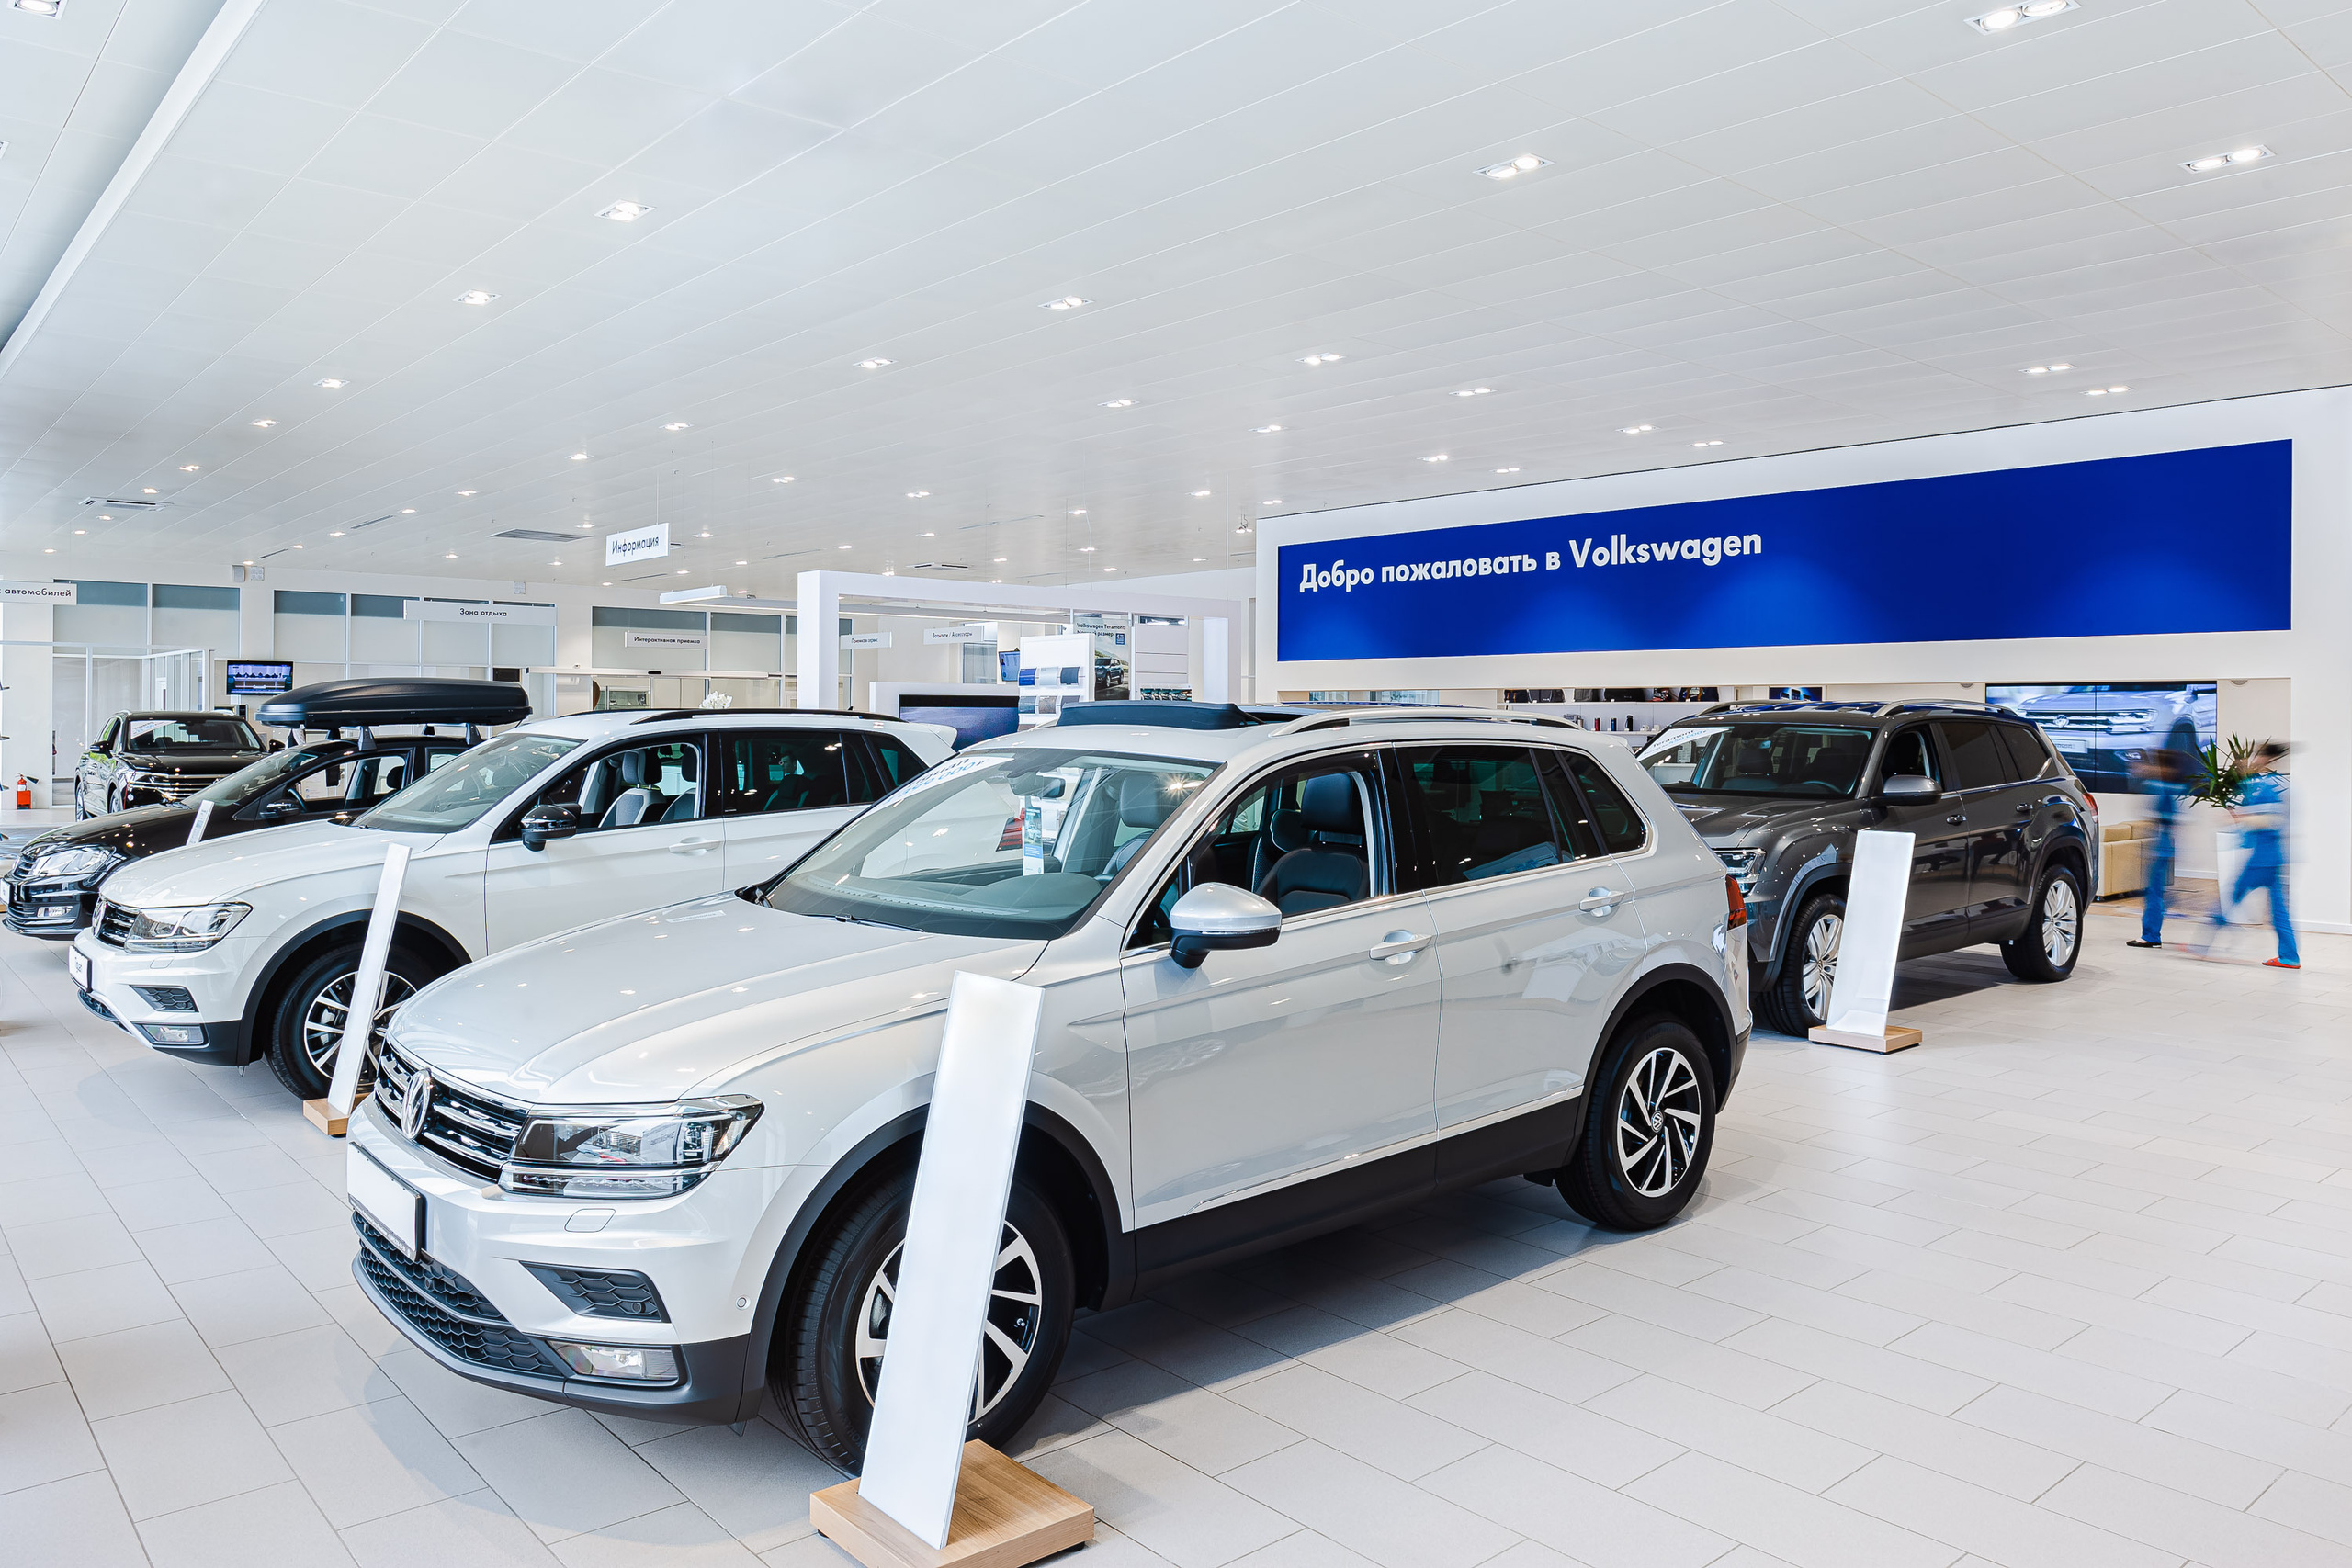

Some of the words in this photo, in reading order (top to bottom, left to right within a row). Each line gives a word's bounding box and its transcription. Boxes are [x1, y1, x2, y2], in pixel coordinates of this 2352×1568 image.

[611, 536, 660, 557] Информация
[1299, 559, 1374, 593] Добро
[1381, 554, 1538, 583] пожаловать
[1545, 551, 1561, 570] в
[1568, 533, 1763, 568] Volkswagen
[4, 588, 72, 597] автомобилей
[459, 607, 479, 615] Зона
[1076, 622, 1103, 630] Volkswagen
